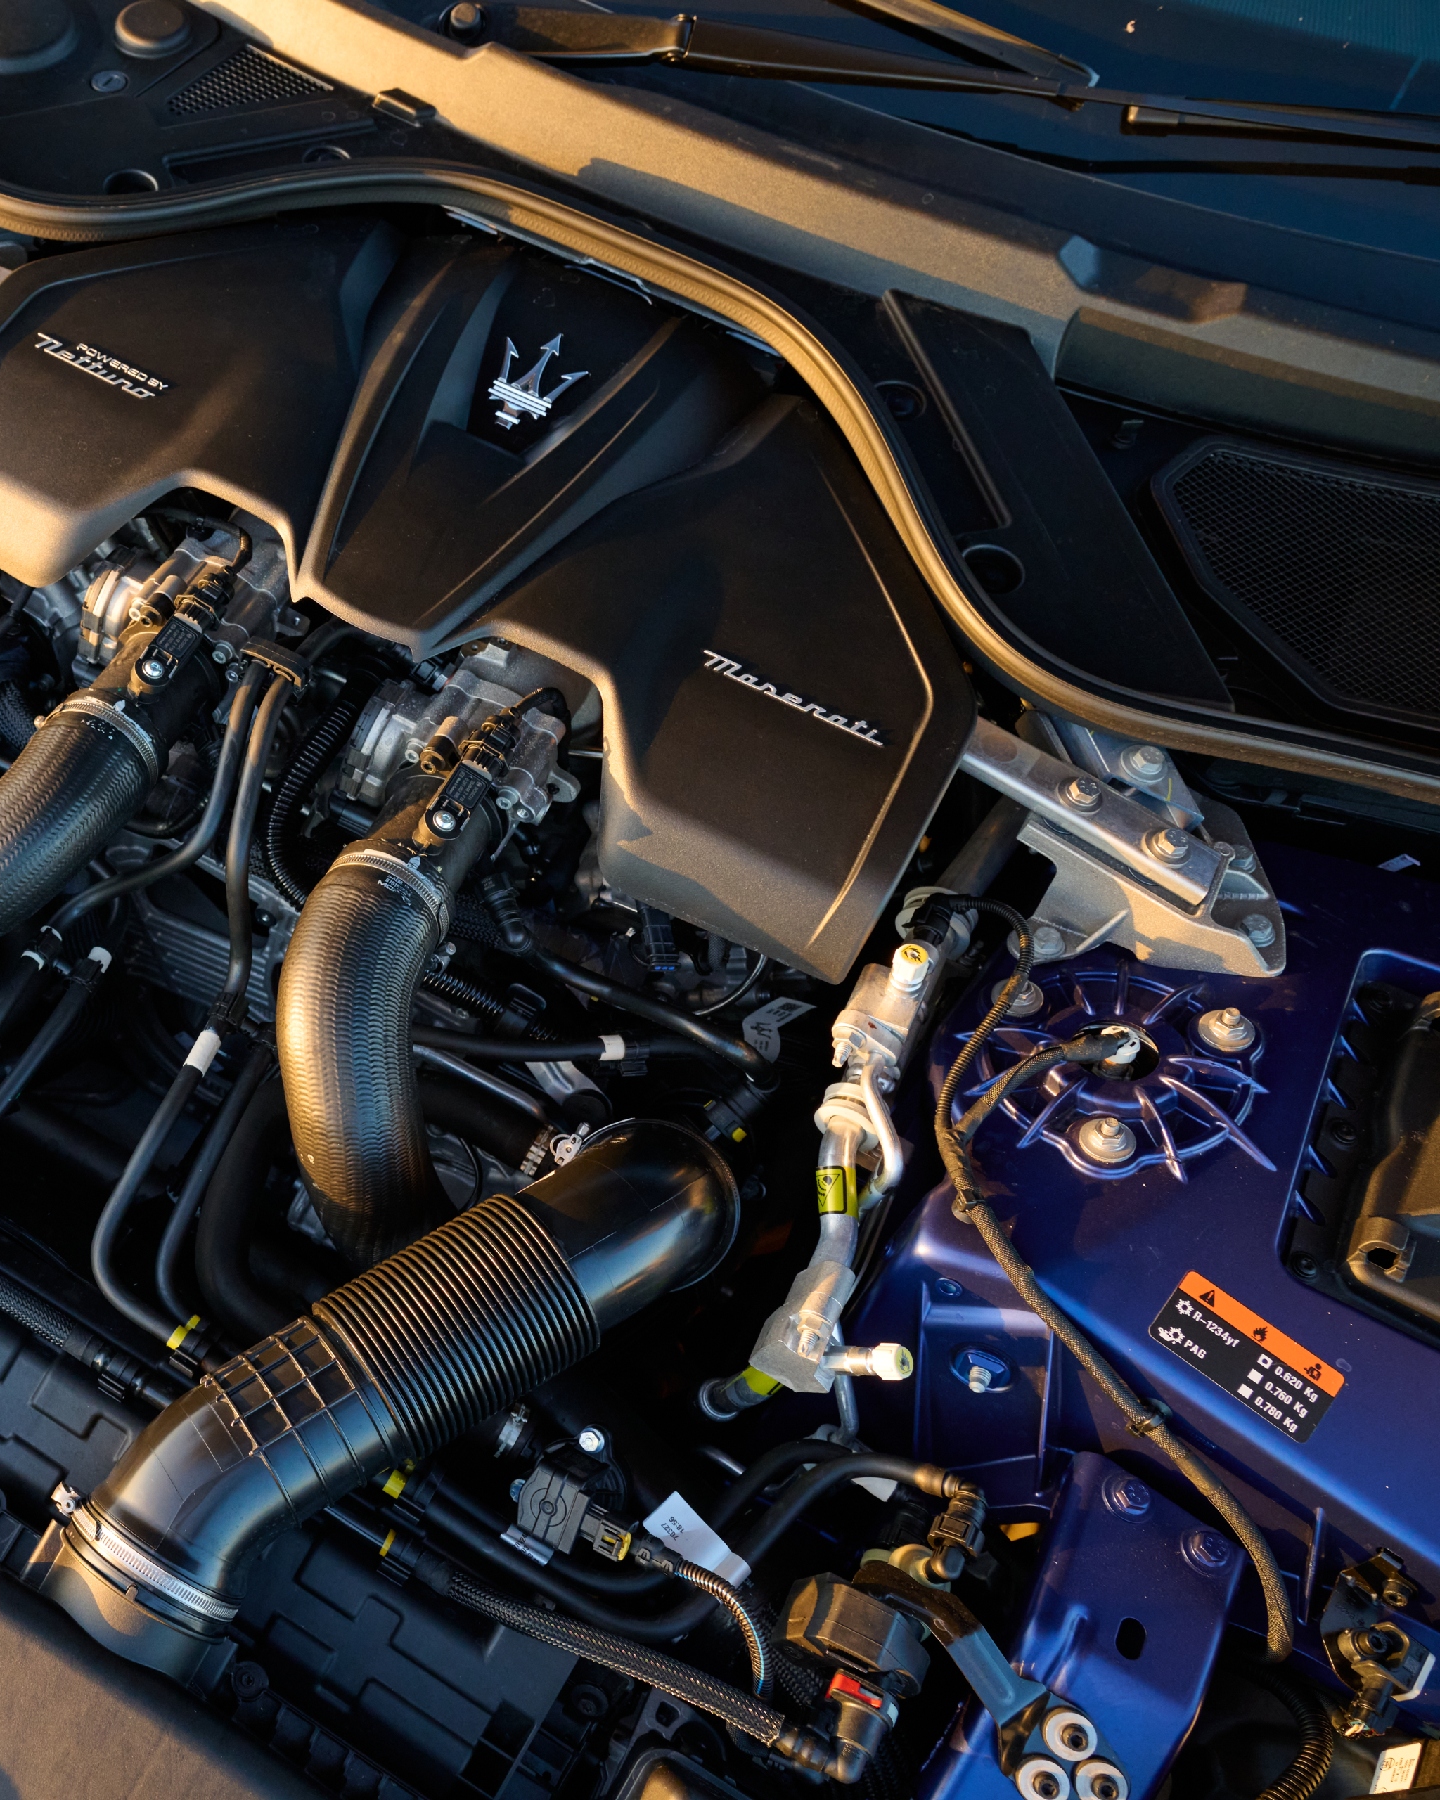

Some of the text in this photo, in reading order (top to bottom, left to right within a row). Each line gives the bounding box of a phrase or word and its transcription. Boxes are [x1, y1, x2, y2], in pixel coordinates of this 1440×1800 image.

[34, 332, 156, 400] Nettuno
[76, 342, 169, 390] POWERED BY
[703, 649, 885, 748] Maserati
[1192, 1310, 1240, 1348] R-1234yf
[1183, 1339, 1208, 1360] PAG
[1264, 1381, 1309, 1419] 0.760 Kg
[1274, 1365, 1319, 1403] 0.620 Kg
[1254, 1395, 1298, 1434] 0.780 Kg
